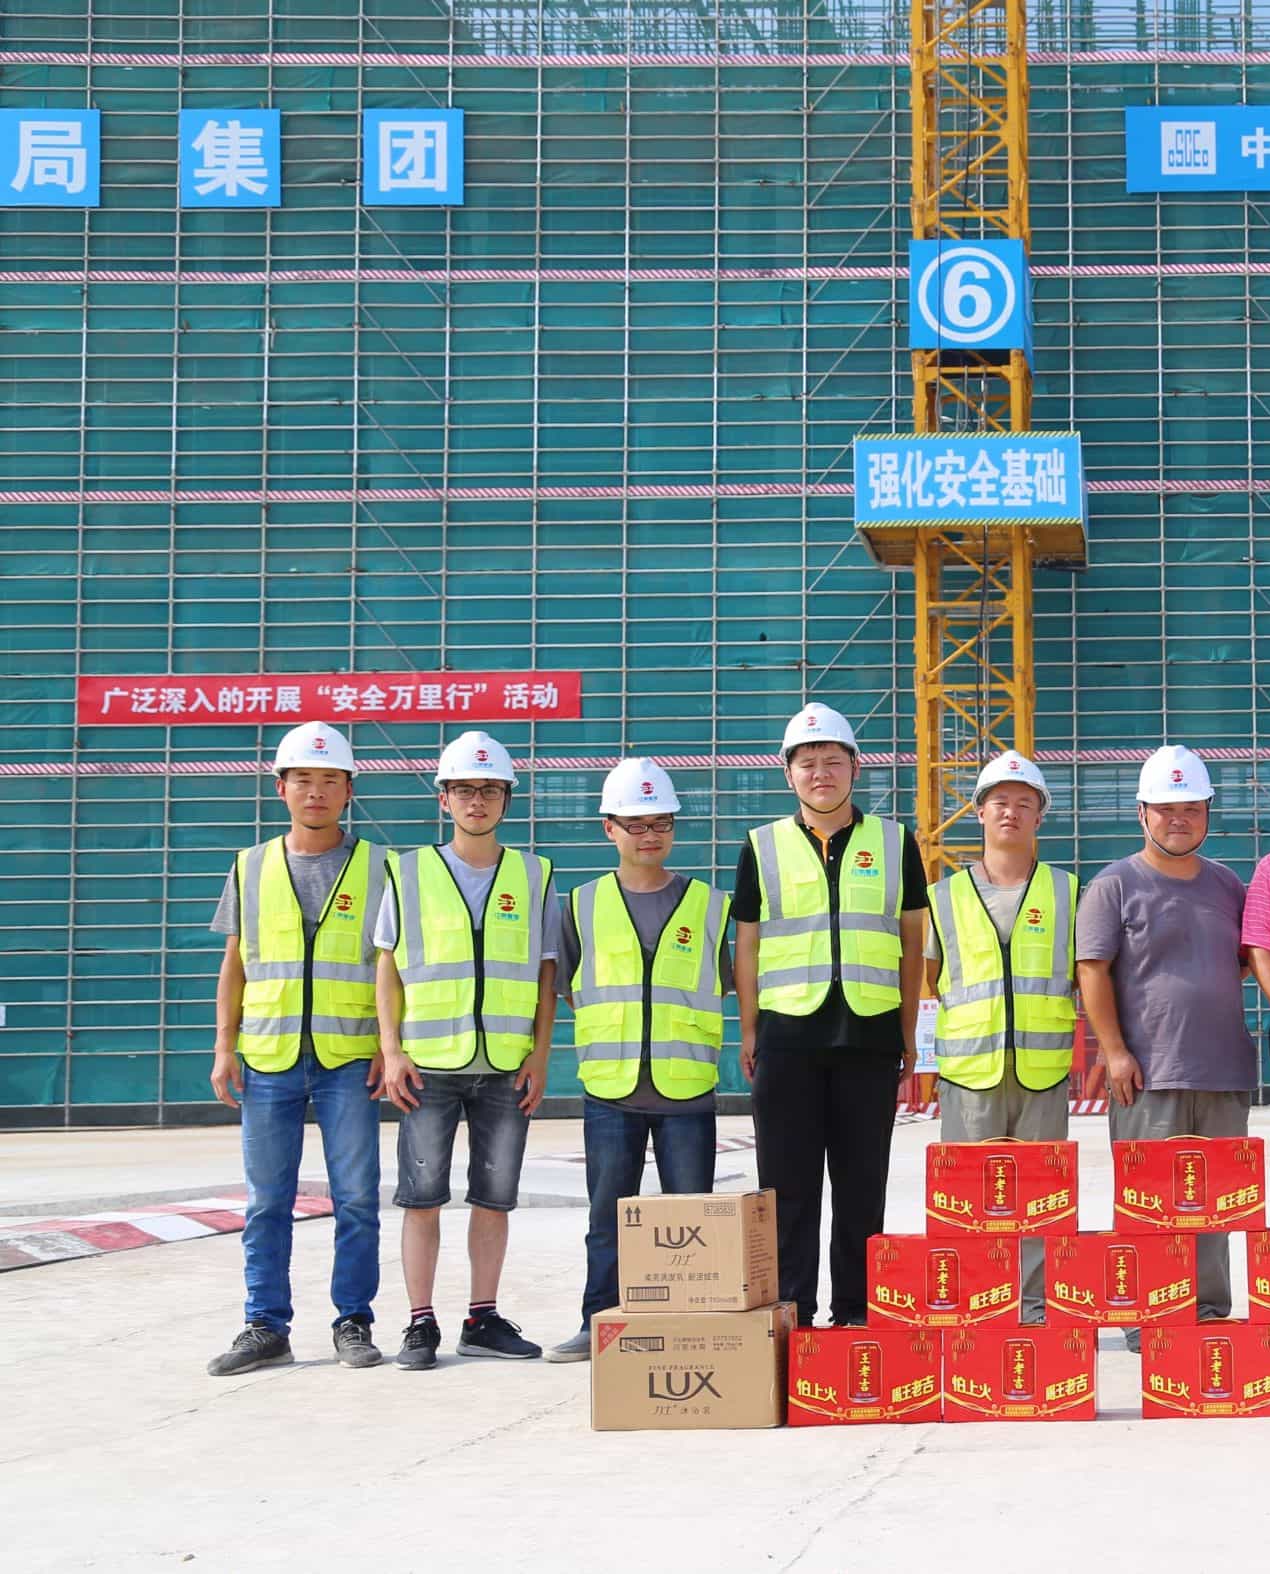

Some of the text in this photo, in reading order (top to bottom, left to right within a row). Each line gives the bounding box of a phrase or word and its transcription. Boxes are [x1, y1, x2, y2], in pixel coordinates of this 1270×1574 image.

[868, 447, 1067, 509] 强化安全基础
[994, 1166, 1006, 1205] 王老吉
[1184, 1161, 1196, 1201] 王老吉
[933, 1190, 973, 1217] 怕上火
[1122, 1186, 1163, 1212] 怕上火
[654, 1226, 707, 1249] LUX
[937, 1259, 949, 1299] 王老吉
[1116, 1255, 1127, 1295] 王老吉
[875, 1284, 916, 1311] 怕上火
[1054, 1281, 1095, 1307] 怕上火
[858, 1352, 871, 1392] 王老吉
[1013, 1349, 1025, 1389] 王老吉
[1210, 1347, 1222, 1387] 王老吉
[648, 1372, 722, 1401] LUX
[796, 1378, 838, 1404] 怕上火
[951, 1374, 993, 1401] 怕上火
[1149, 1373, 1191, 1400] 怕上火
